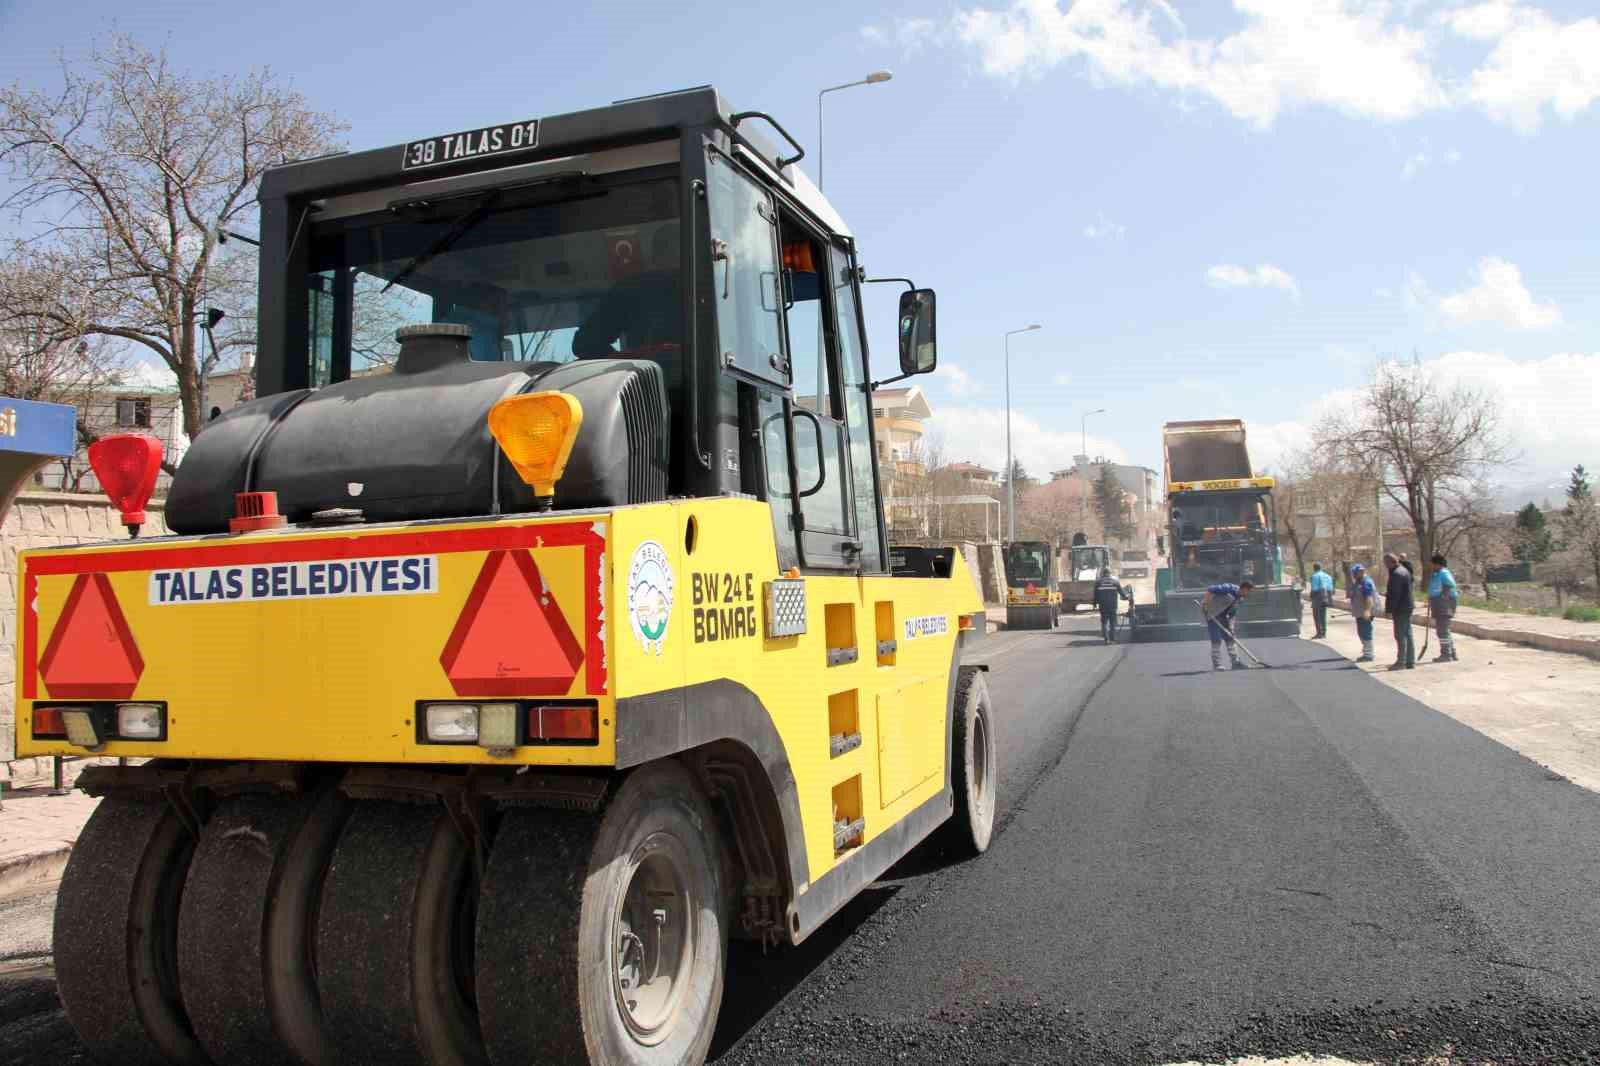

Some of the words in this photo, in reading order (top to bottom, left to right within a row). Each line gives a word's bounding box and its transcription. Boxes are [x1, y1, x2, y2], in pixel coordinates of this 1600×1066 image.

[411, 140, 435, 165] 38
[443, 128, 504, 160] TALAS
[511, 122, 536, 147] 01
[155, 569, 243, 602] TALAS
[692, 573, 719, 605] BW
[694, 606, 756, 643] BOMAG
